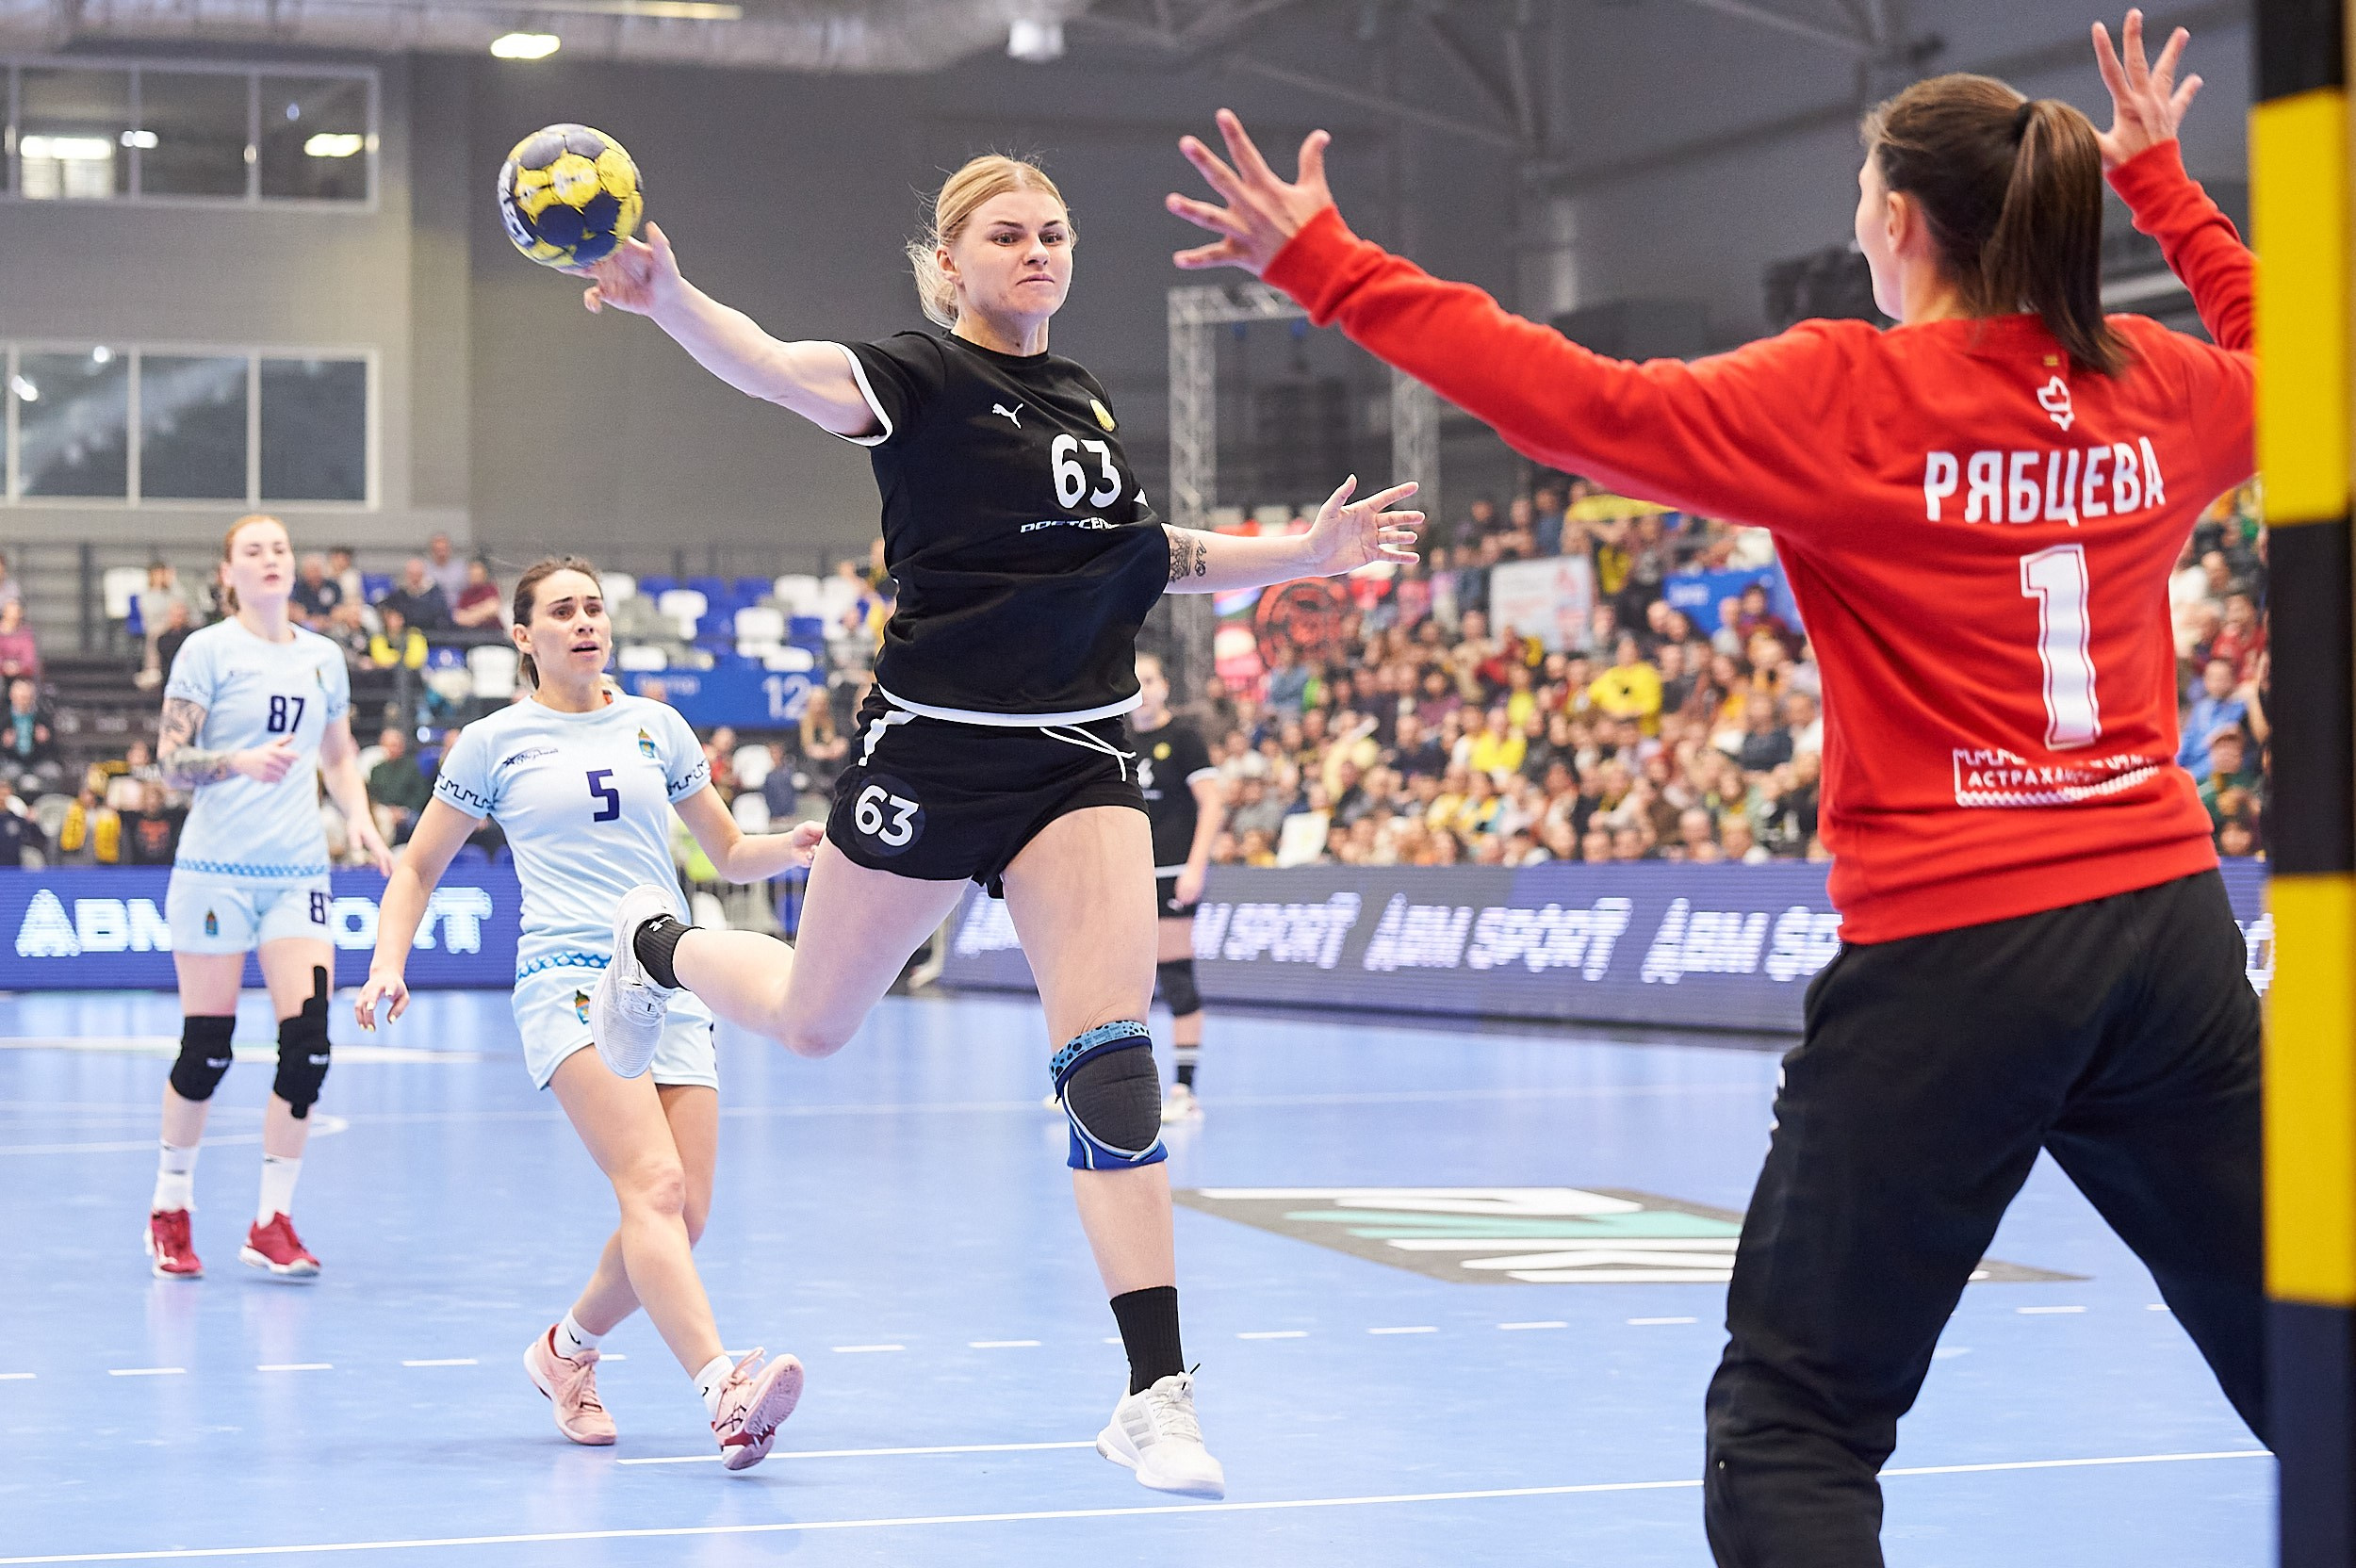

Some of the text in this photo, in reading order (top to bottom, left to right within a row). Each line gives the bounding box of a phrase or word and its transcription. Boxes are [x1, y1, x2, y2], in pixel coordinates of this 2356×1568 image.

[1051, 433, 1121, 509] 63
[1923, 436, 2166, 528] РЯБЦЕВА
[2020, 543, 2102, 751] 1
[268, 695, 304, 732] 87
[761, 673, 812, 721] 12
[586, 769, 619, 822] 5
[855, 784, 920, 846] 63
